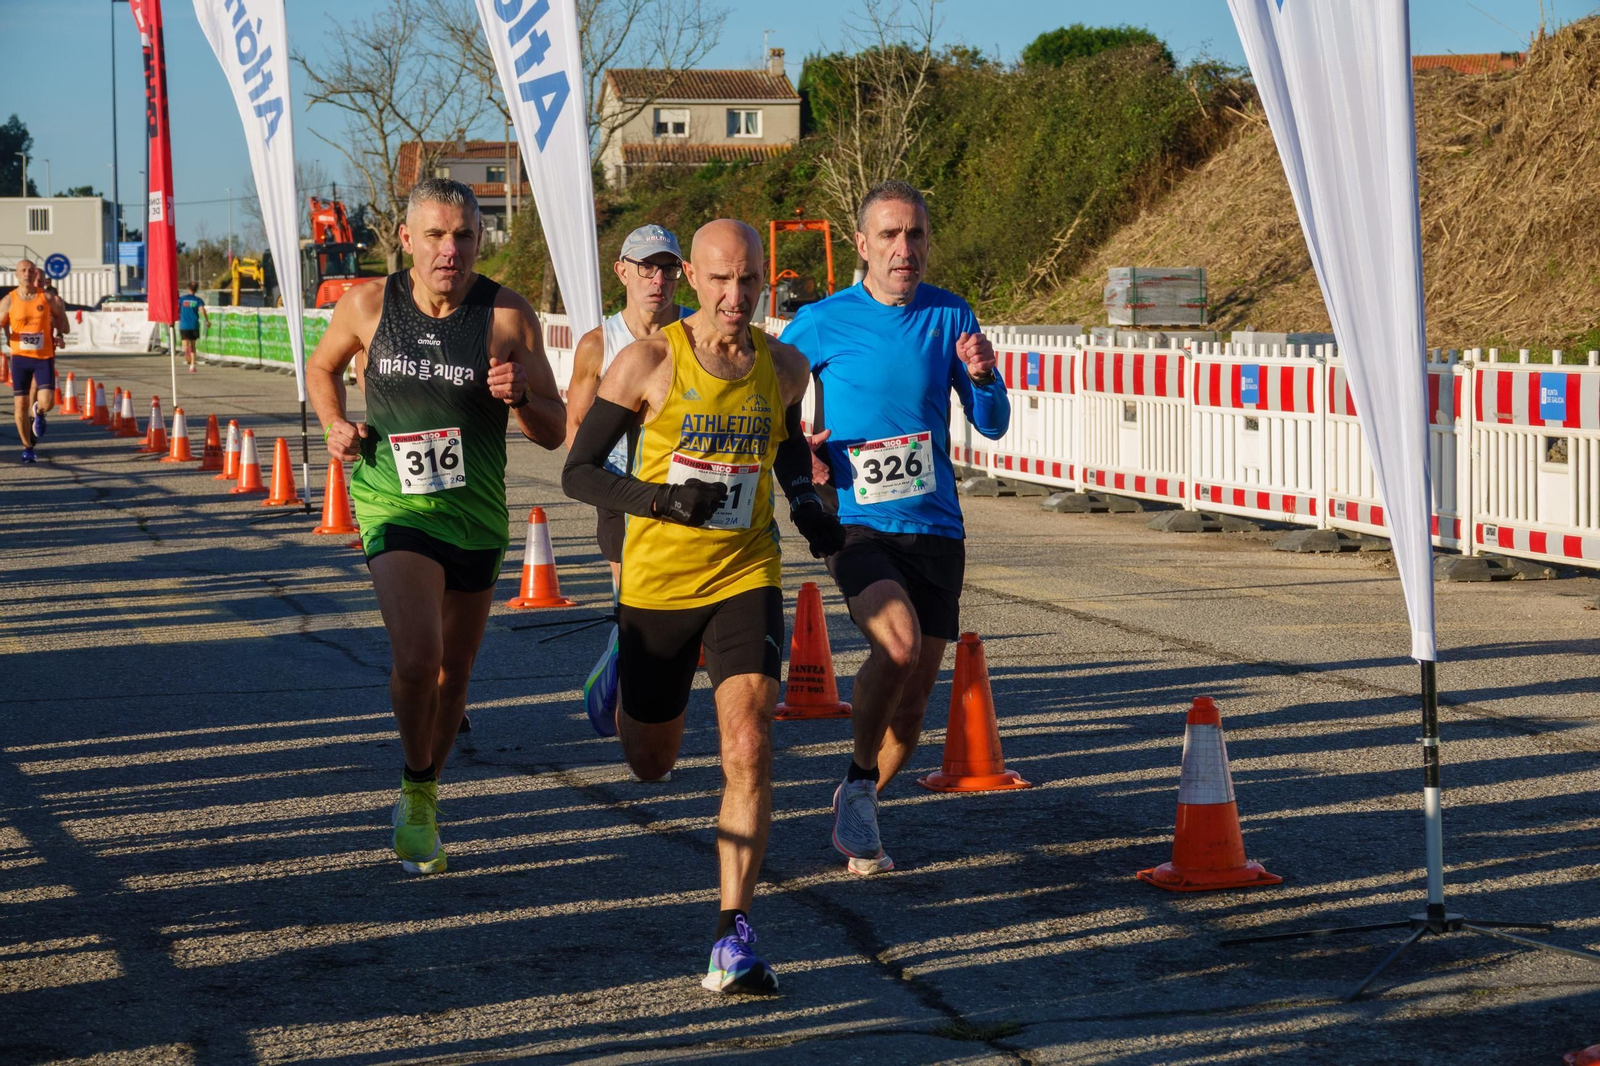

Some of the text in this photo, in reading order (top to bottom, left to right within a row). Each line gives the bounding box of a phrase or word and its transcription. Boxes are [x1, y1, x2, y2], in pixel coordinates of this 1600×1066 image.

[23, 337, 40, 345] 327
[417, 338, 441, 346] amura
[379, 353, 474, 386] máis que auga
[681, 413, 772, 435] ATHLETICS
[681, 434, 768, 455] SAN LÁZARO
[406, 445, 459, 476] 316
[863, 451, 922, 485] 326
